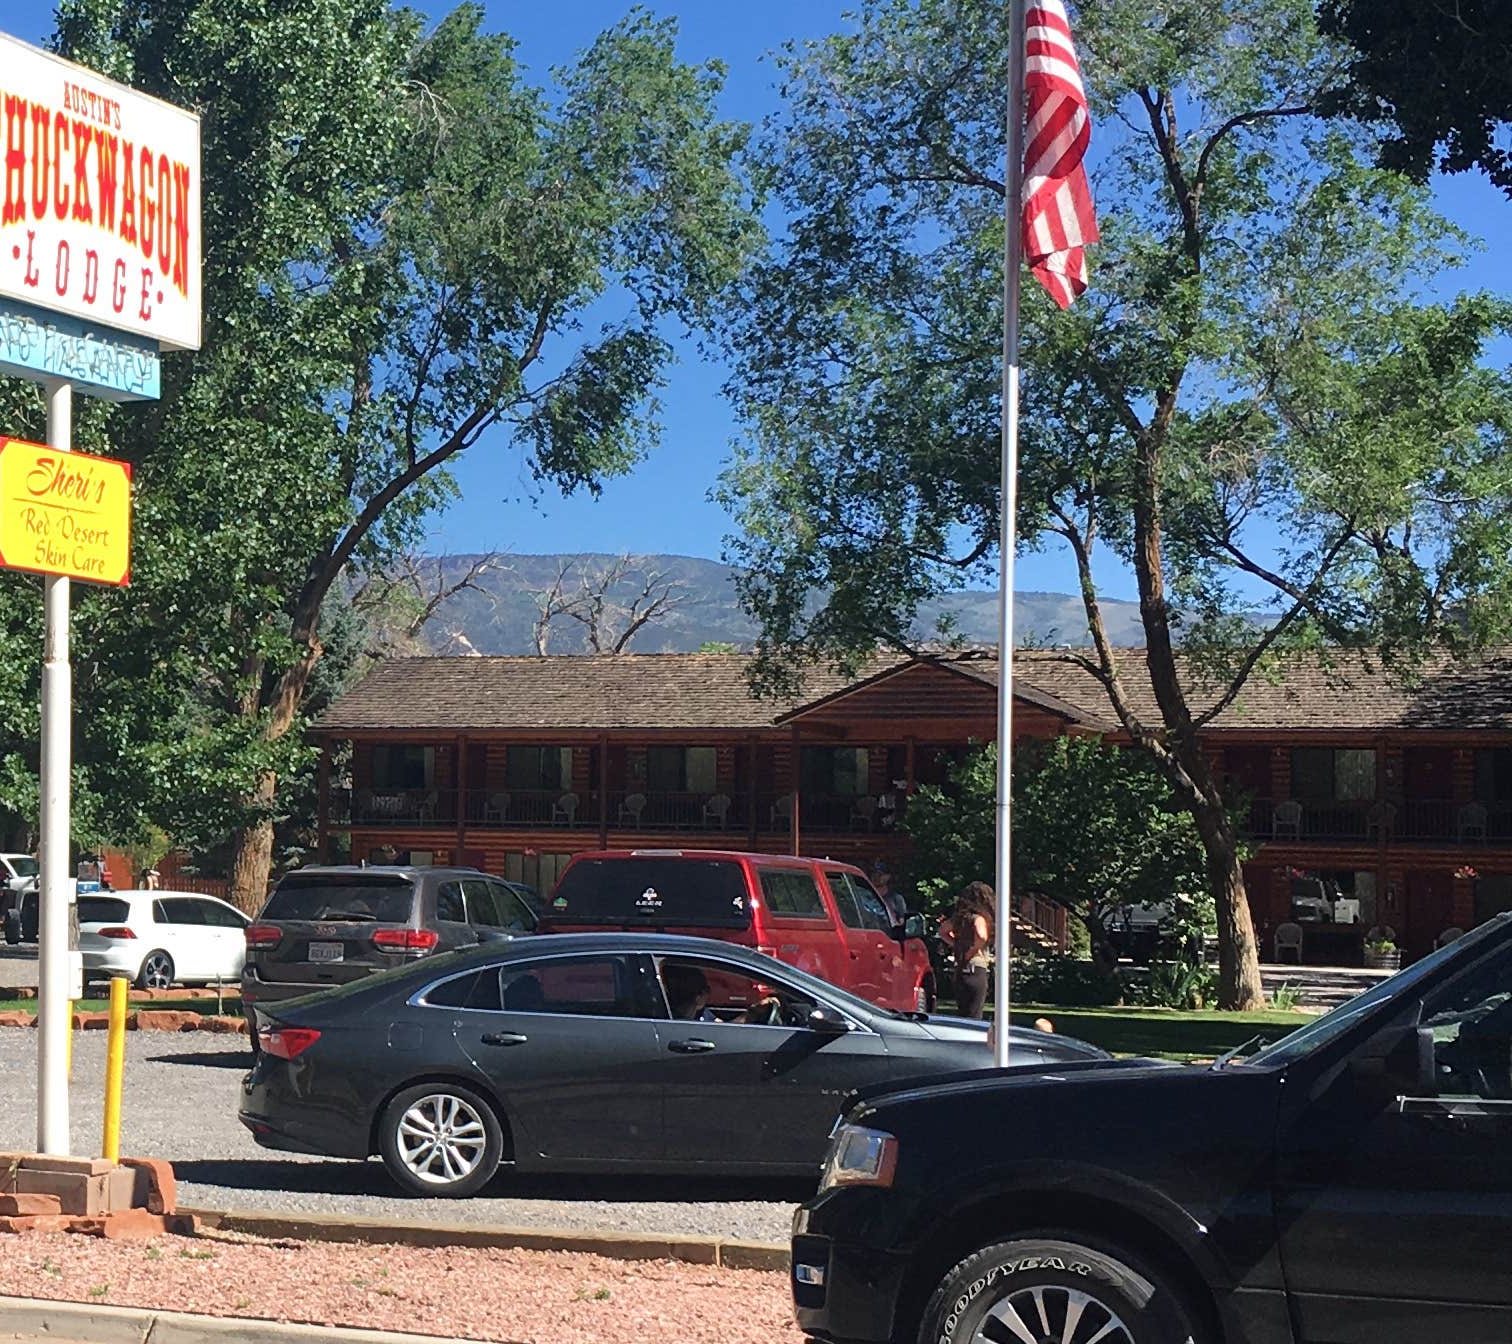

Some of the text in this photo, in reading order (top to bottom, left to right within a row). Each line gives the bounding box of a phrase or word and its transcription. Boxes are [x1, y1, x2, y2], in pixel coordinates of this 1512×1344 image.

[64, 80, 121, 130] AUSTIN'S
[24, 229, 153, 321] LODGE
[26, 458, 105, 504] Sheri's
[20, 508, 109, 546] Red Desert
[34, 539, 105, 574] Skin Care
